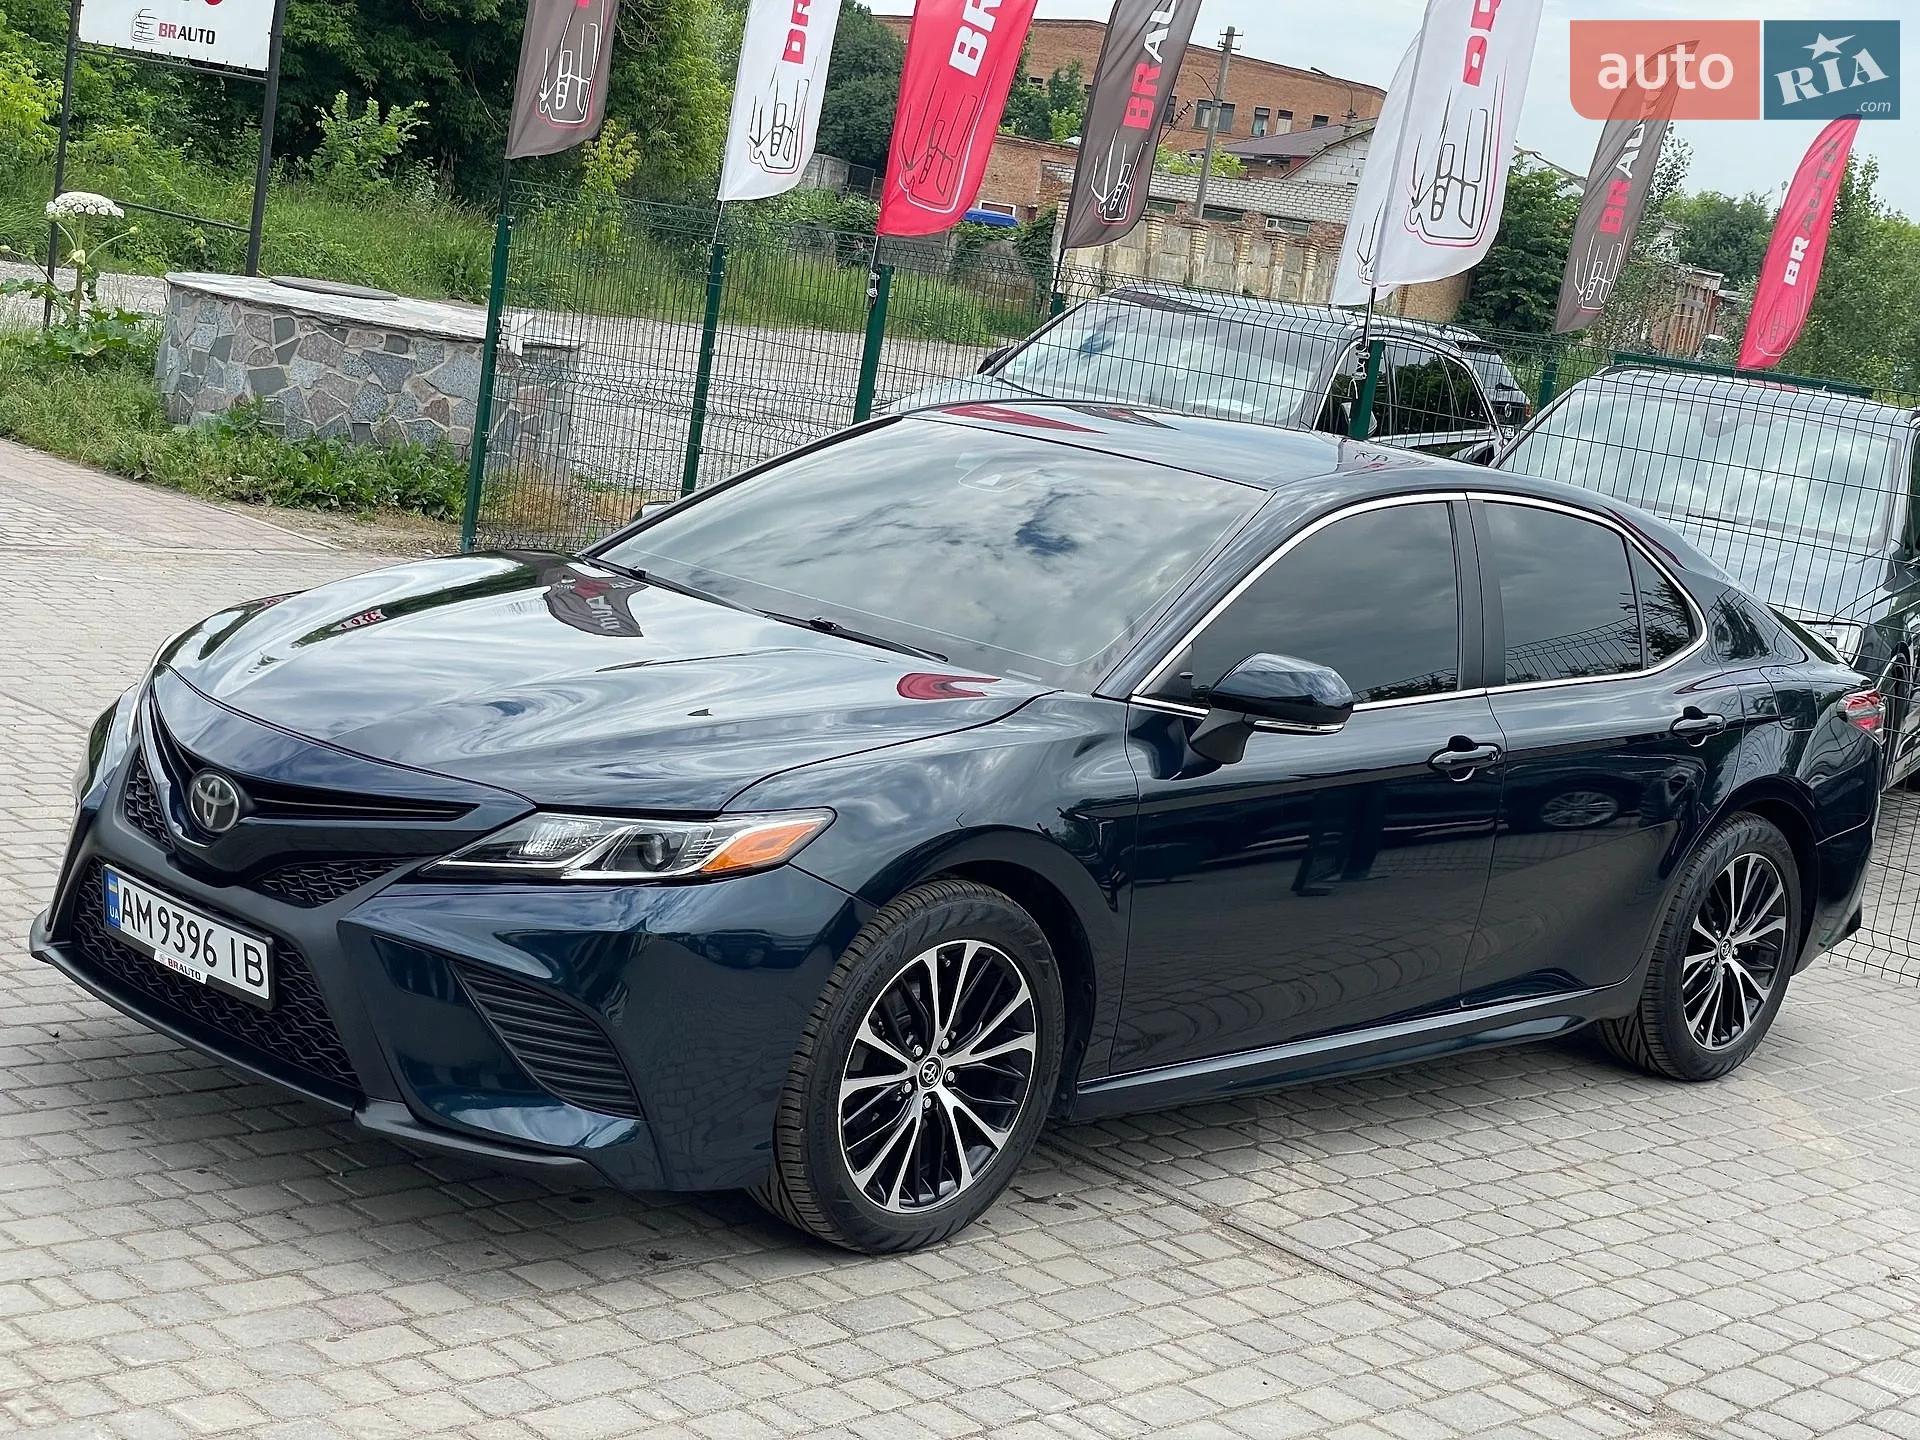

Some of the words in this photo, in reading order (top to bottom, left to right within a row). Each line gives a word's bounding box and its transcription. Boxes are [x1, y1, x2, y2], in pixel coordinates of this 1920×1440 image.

[158, 22, 216, 45] BRAUTO
[948, 0, 1003, 78] BR
[1783, 138, 1841, 286] BRAUTO
[109, 904, 120, 921] UA
[167, 957, 202, 981] BRAUTO
